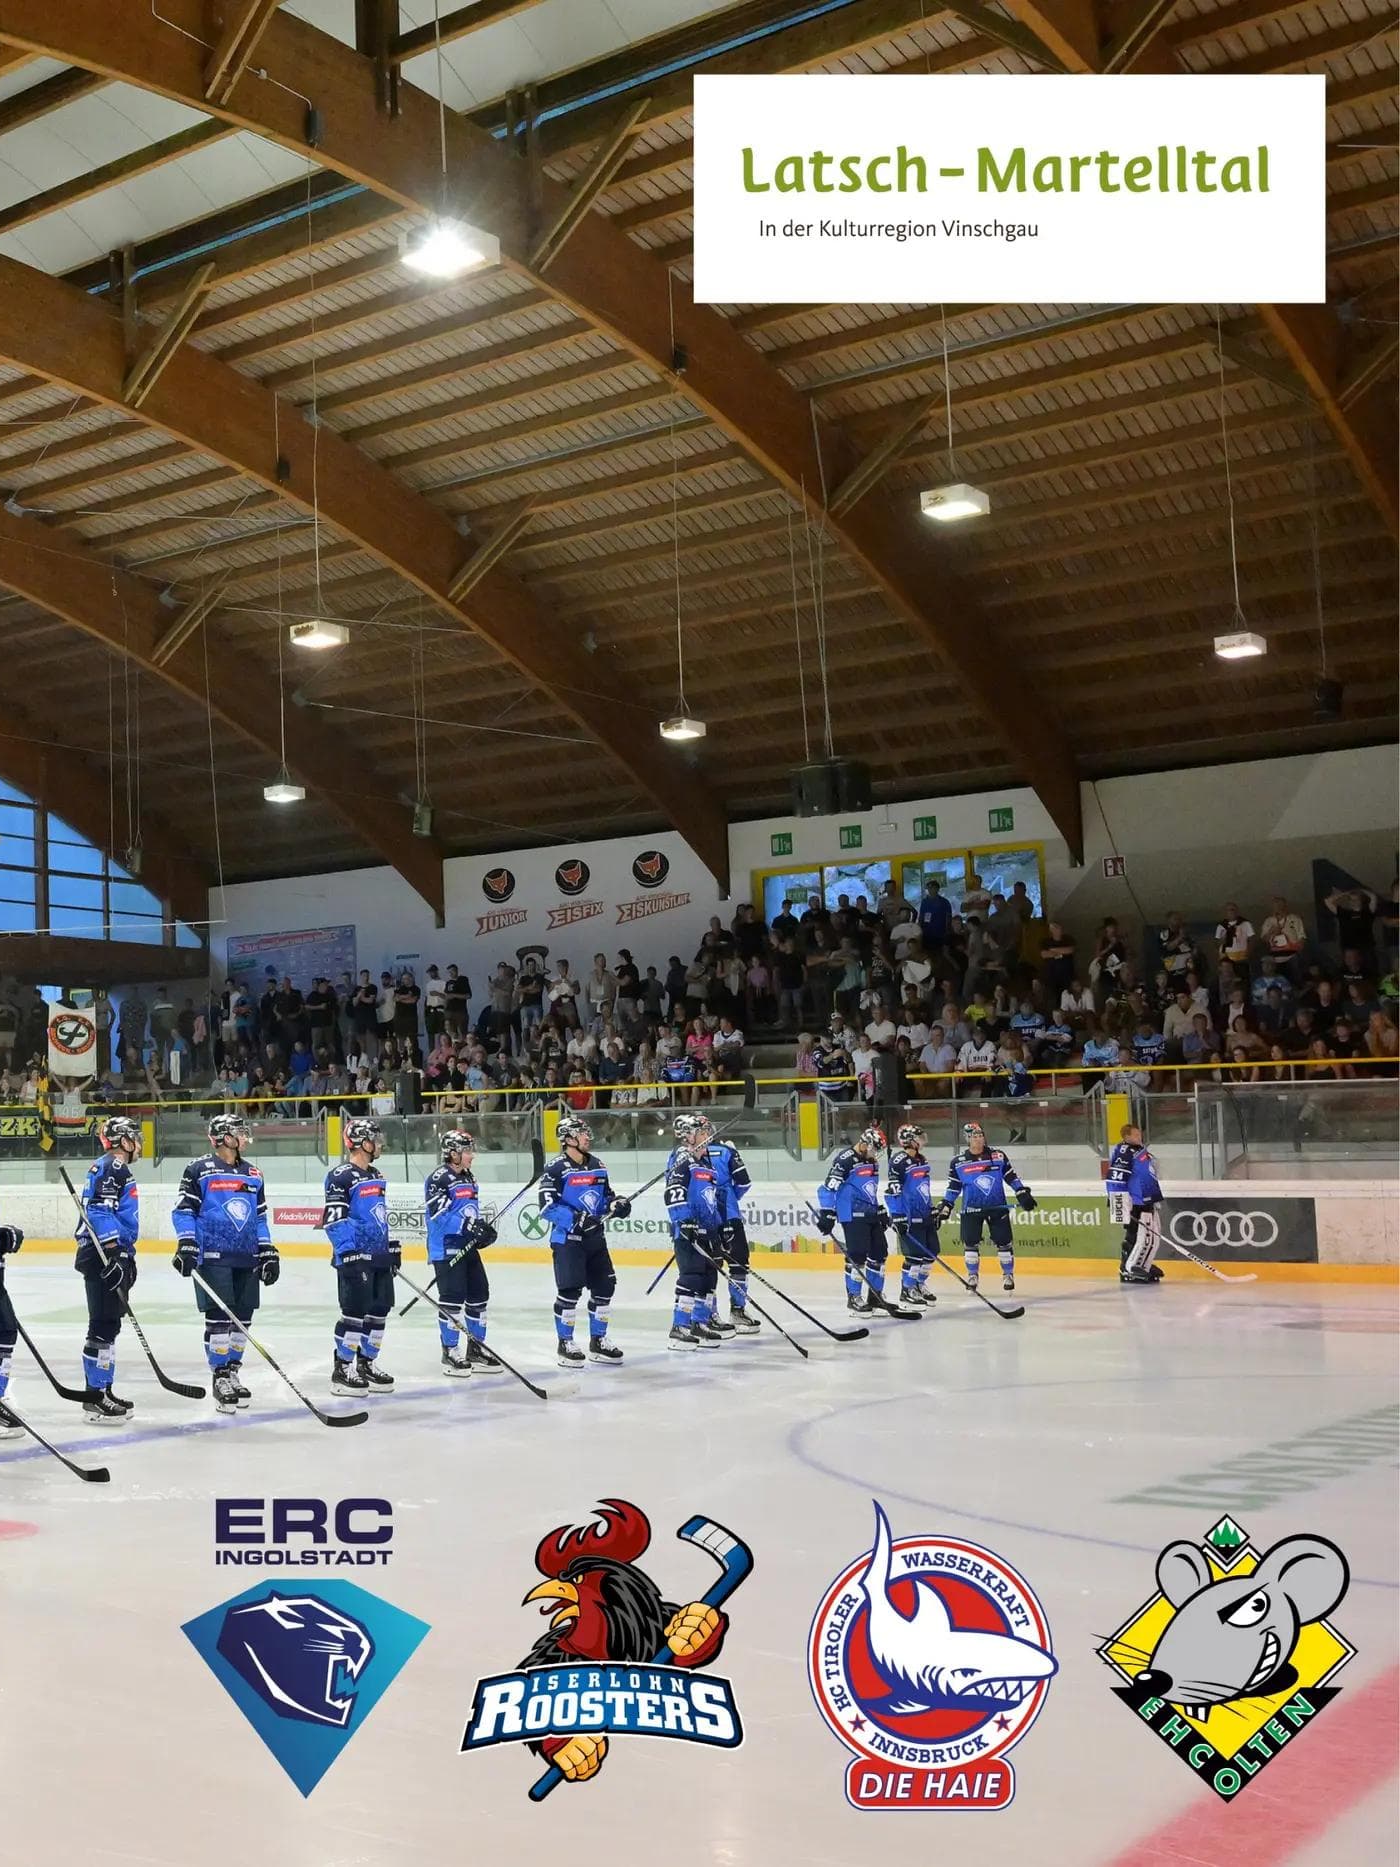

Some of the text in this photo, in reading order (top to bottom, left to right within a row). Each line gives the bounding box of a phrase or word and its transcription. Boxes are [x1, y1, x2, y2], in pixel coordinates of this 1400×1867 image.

[478, 911, 527, 935] JUNIOR
[669, 1189, 685, 1201] 22
[327, 1207, 343, 1222] 21
[387, 1212, 425, 1228] ORST
